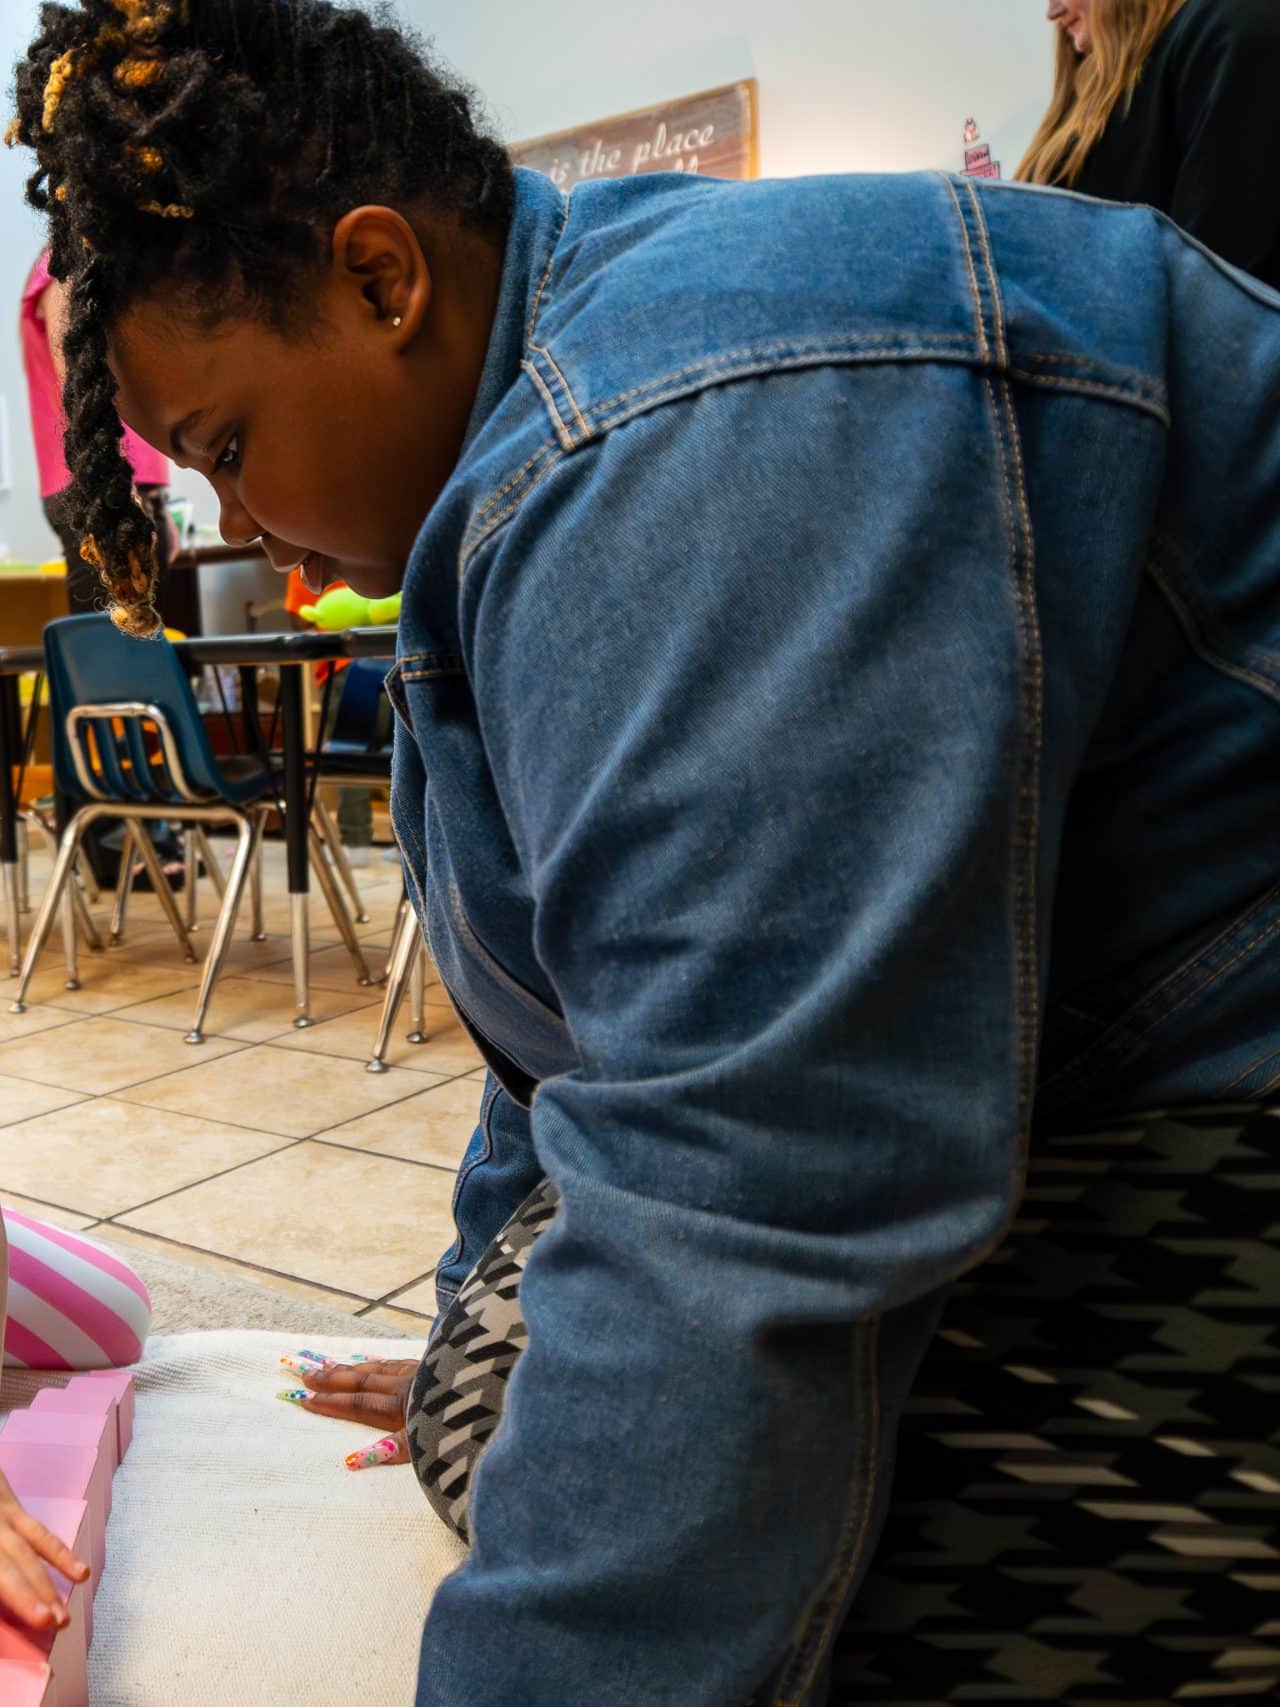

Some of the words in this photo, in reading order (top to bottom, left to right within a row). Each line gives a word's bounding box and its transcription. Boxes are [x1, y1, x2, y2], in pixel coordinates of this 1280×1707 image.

[549, 158, 570, 184] is
[579, 138, 621, 176] the
[631, 121, 715, 175] place
